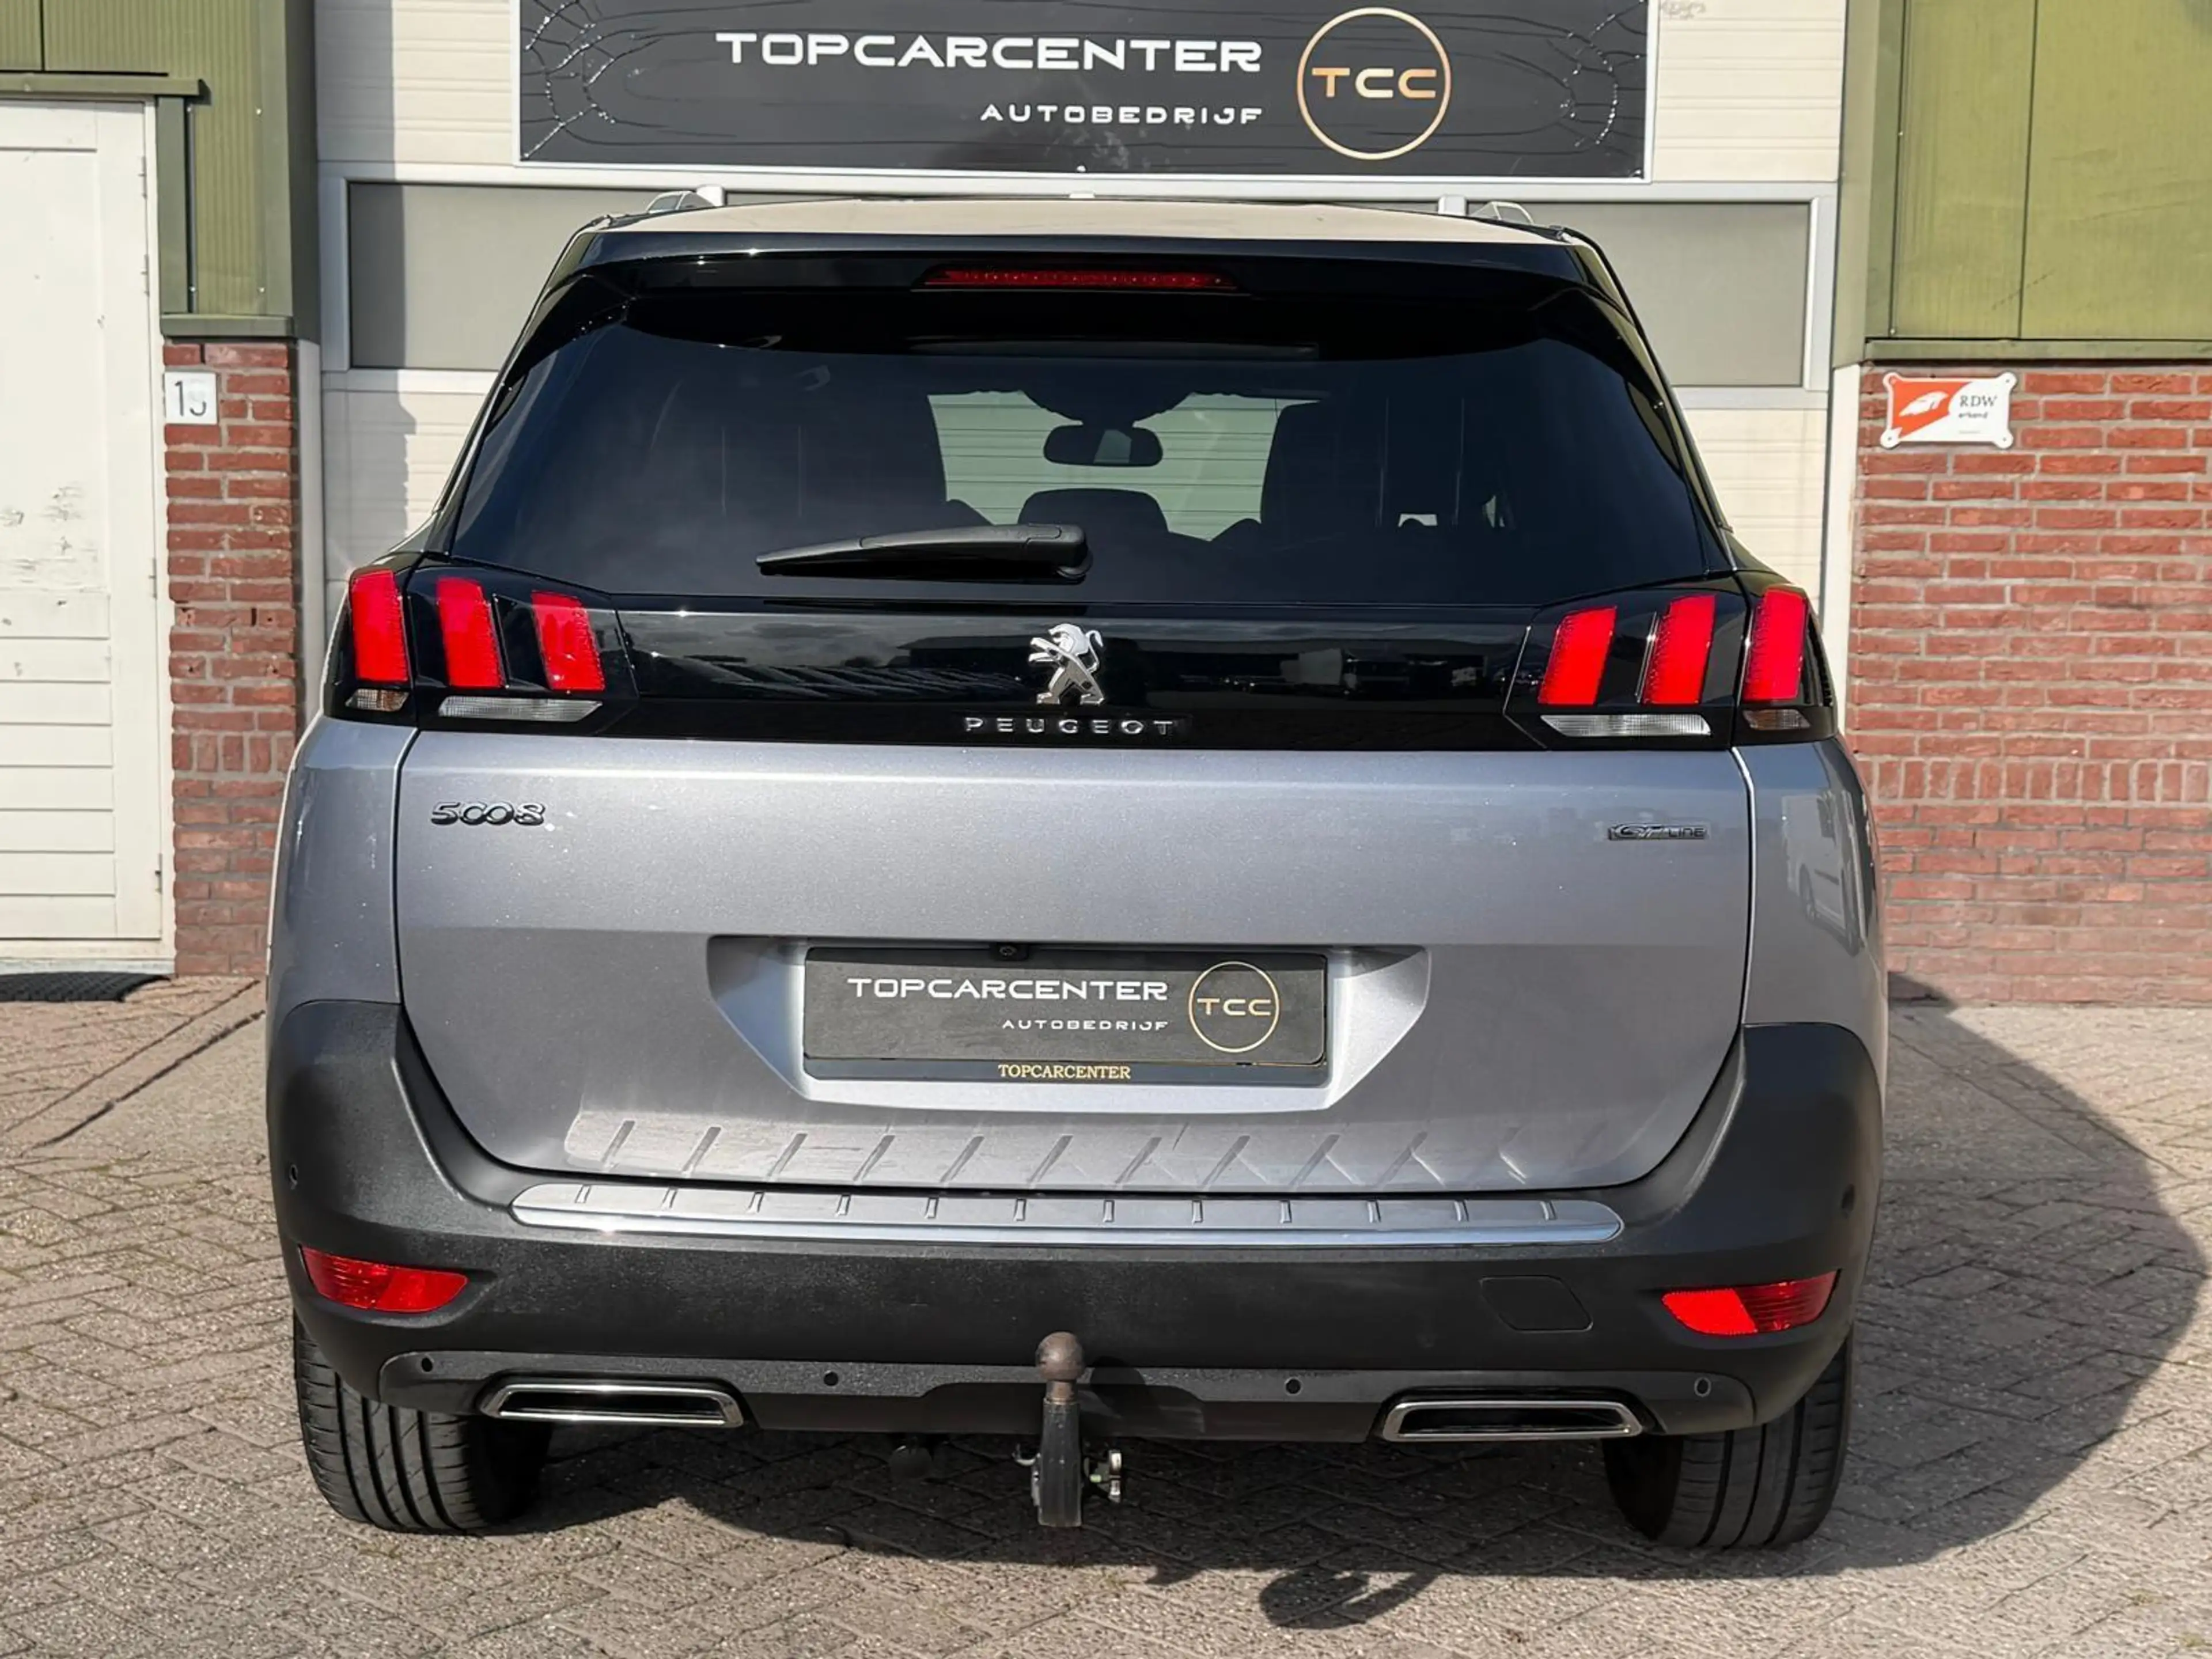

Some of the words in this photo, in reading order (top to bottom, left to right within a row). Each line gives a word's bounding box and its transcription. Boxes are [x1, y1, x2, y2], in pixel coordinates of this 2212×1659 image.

[715, 32, 1262, 73] TOPCARCENTER
[1311, 67, 1437, 99] TCC
[980, 103, 1263, 125] AUTOBEDRIJF
[1959, 395, 1998, 407] RDW
[964, 717, 1173, 735] PEUGEOT
[431, 801, 546, 825] 5008
[846, 977, 1168, 1001] TOPCARCENTER
[1196, 997, 1272, 1017] TCC
[1001, 1018, 1169, 1032] AUTOBEDRIJF
[998, 1064, 1131, 1080] TOPCARCENTER
